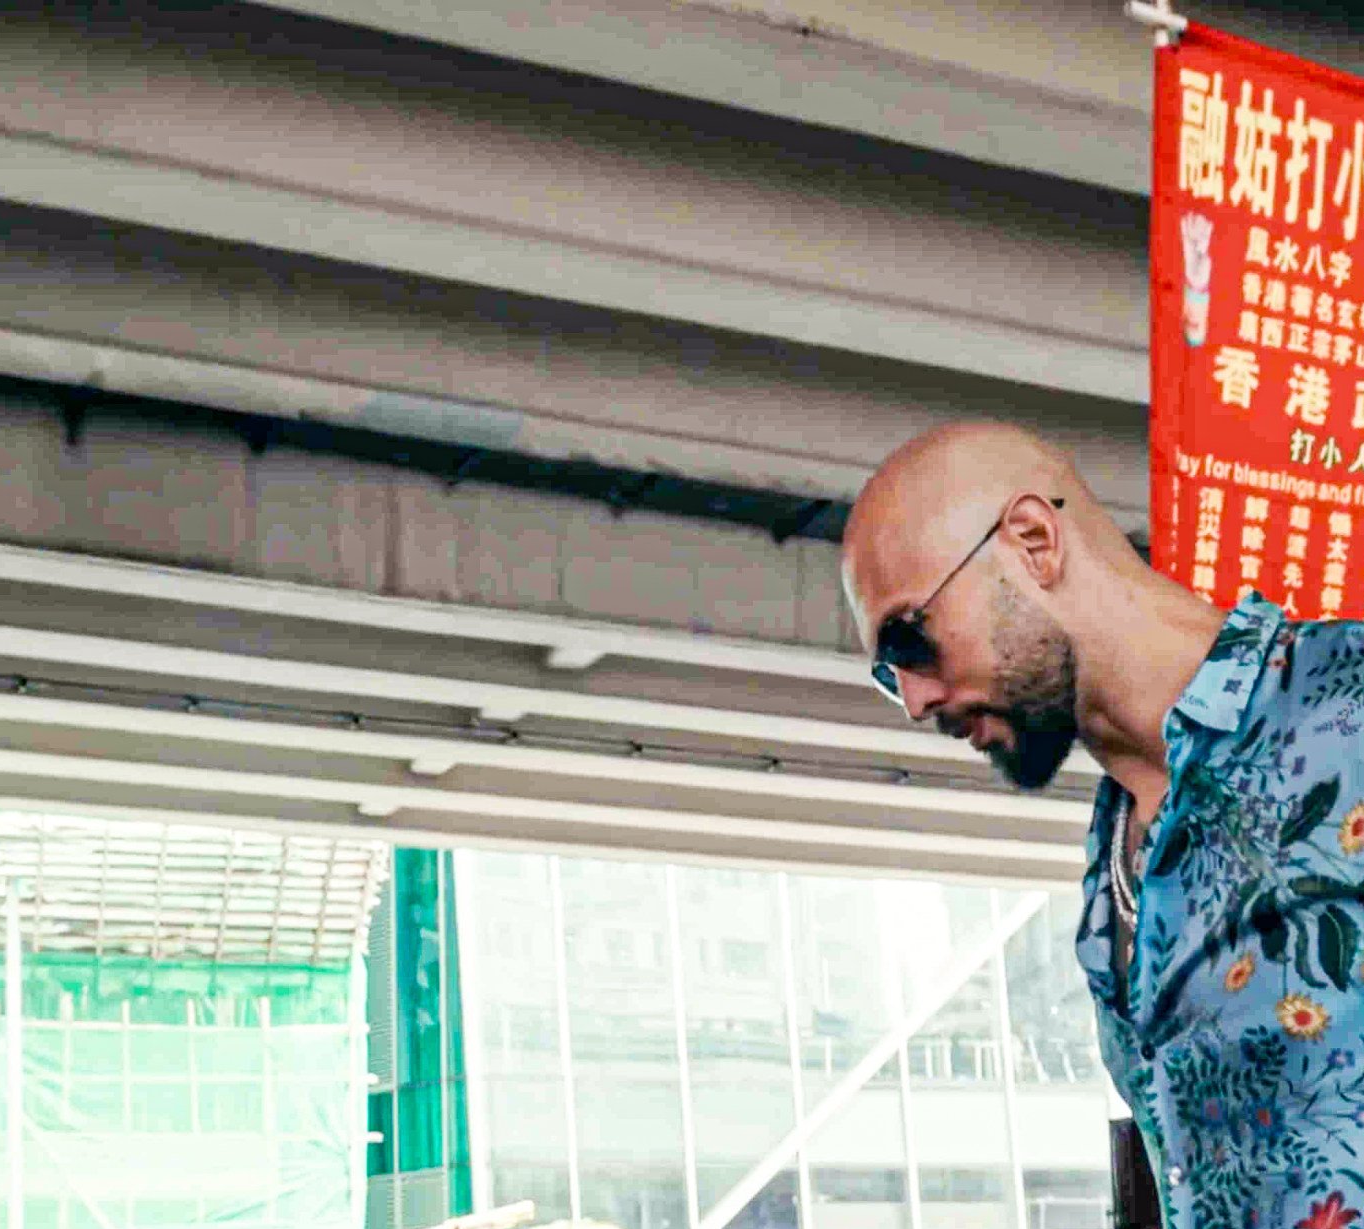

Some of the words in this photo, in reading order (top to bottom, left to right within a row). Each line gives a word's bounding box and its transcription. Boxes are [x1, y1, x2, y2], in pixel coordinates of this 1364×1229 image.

[1245, 226, 1352, 289] 風水八字
[1204, 453, 1234, 480] for
[1233, 461, 1316, 500] blessings
[1318, 482, 1352, 505] and
